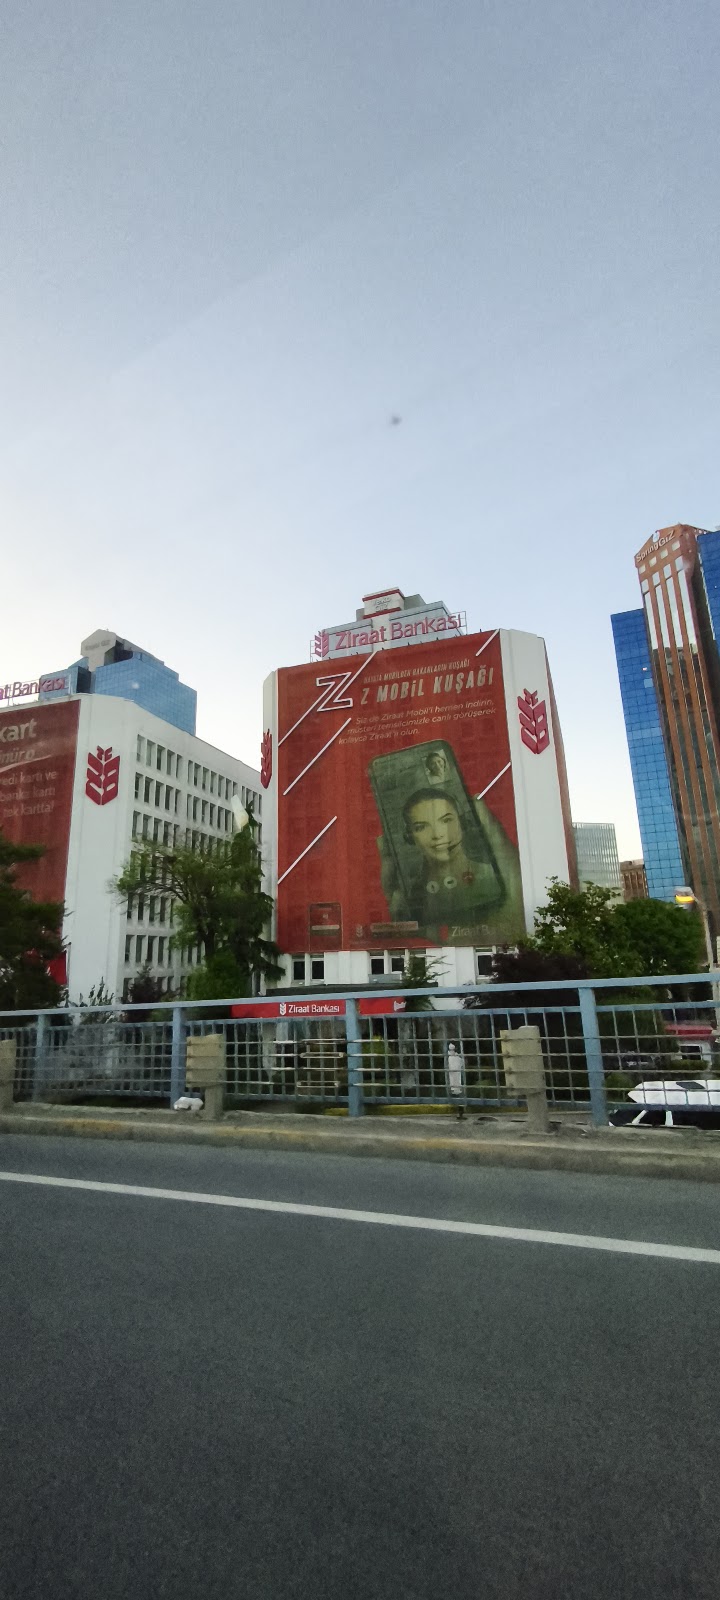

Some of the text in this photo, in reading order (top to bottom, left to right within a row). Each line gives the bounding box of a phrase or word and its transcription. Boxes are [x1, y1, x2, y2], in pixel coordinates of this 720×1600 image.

[335, 613, 462, 651] Ziraat Bankası
[361, 665, 494, 705] Z MOBİL KUŞAĞI
[435, 703, 463, 713] hemen
[431, 713, 451, 724] canlı
[45, 771, 57, 780] ve
[288, 1004, 340, 1013] Ziraat Bankası
